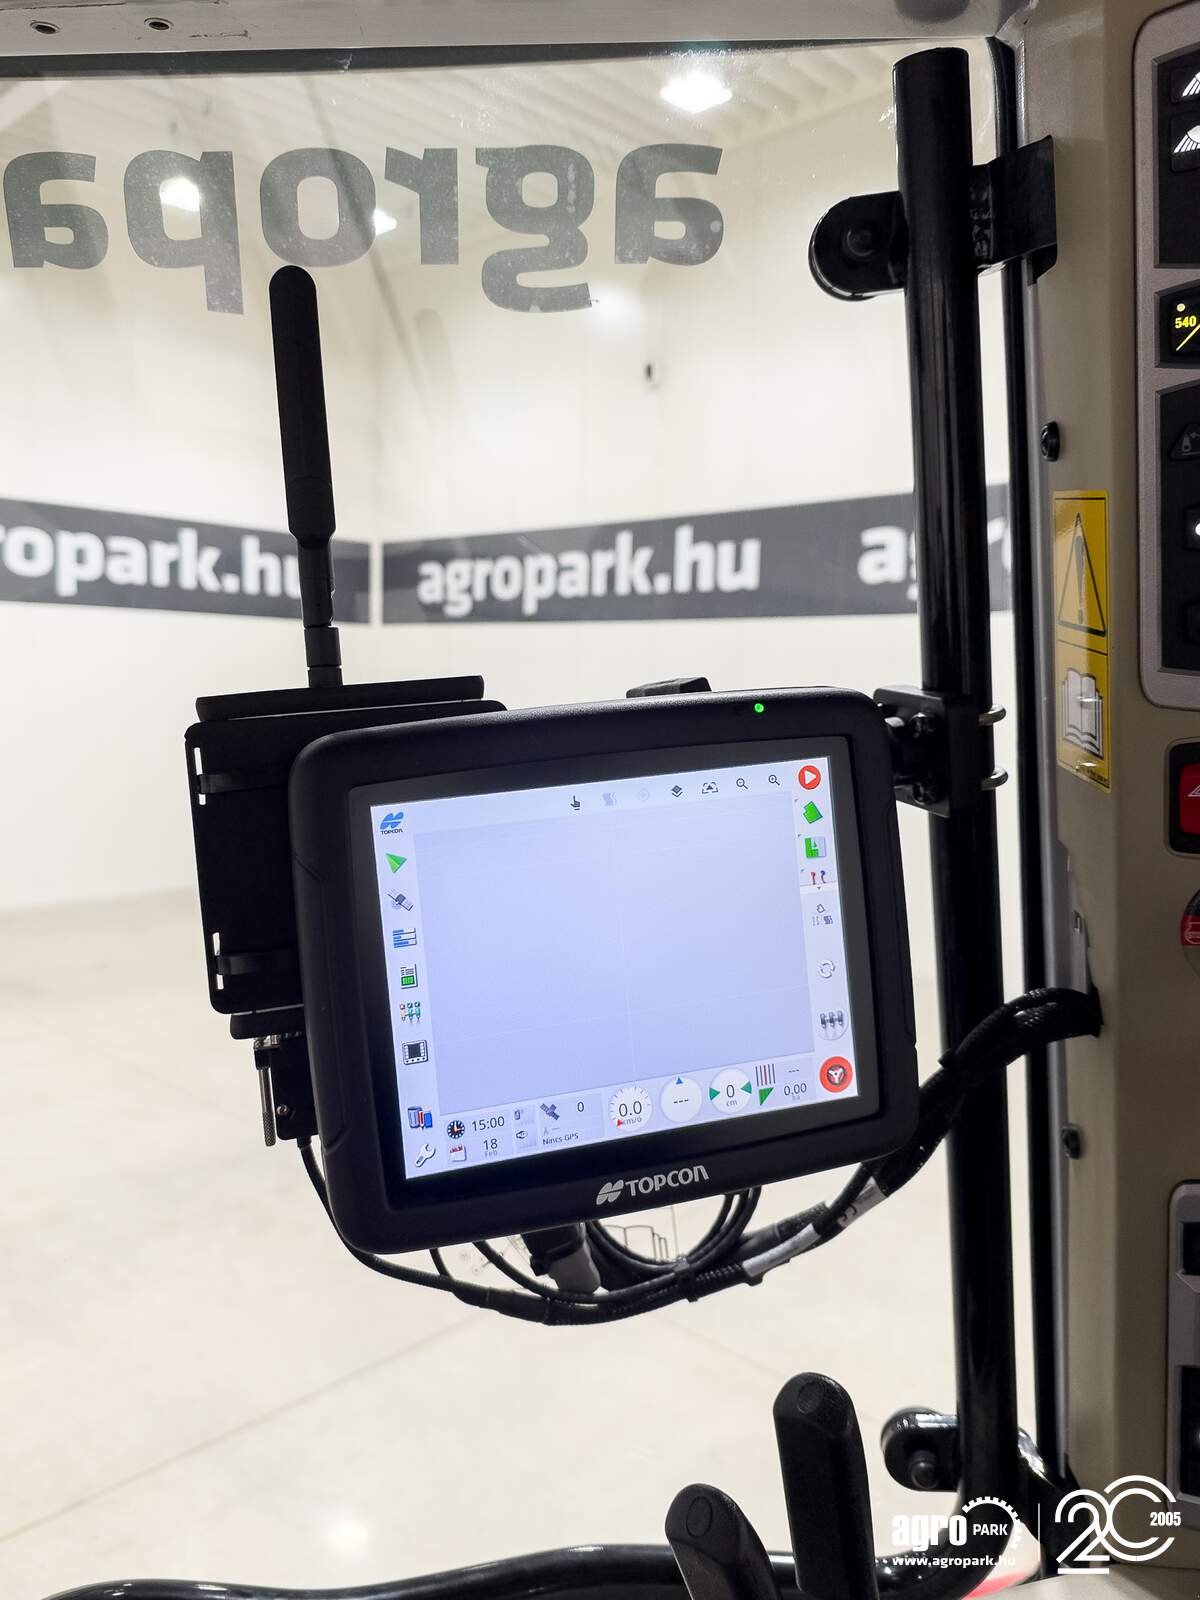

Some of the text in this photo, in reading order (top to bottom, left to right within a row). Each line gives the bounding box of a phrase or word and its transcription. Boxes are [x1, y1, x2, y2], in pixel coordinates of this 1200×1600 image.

[1175, 315, 1197, 329] 540
[417, 524, 762, 618] agropark.hu
[726, 1084, 735, 1098] 0
[784, 1082, 807, 1096] 0.00
[577, 1101, 585, 1113] 0
[618, 1100, 642, 1118] 0.0
[471, 1115, 505, 1132] 15:00
[564, 1132, 579, 1141] GPS
[483, 1138, 498, 1151] 18
[625, 1164, 710, 1197] TOPCON
